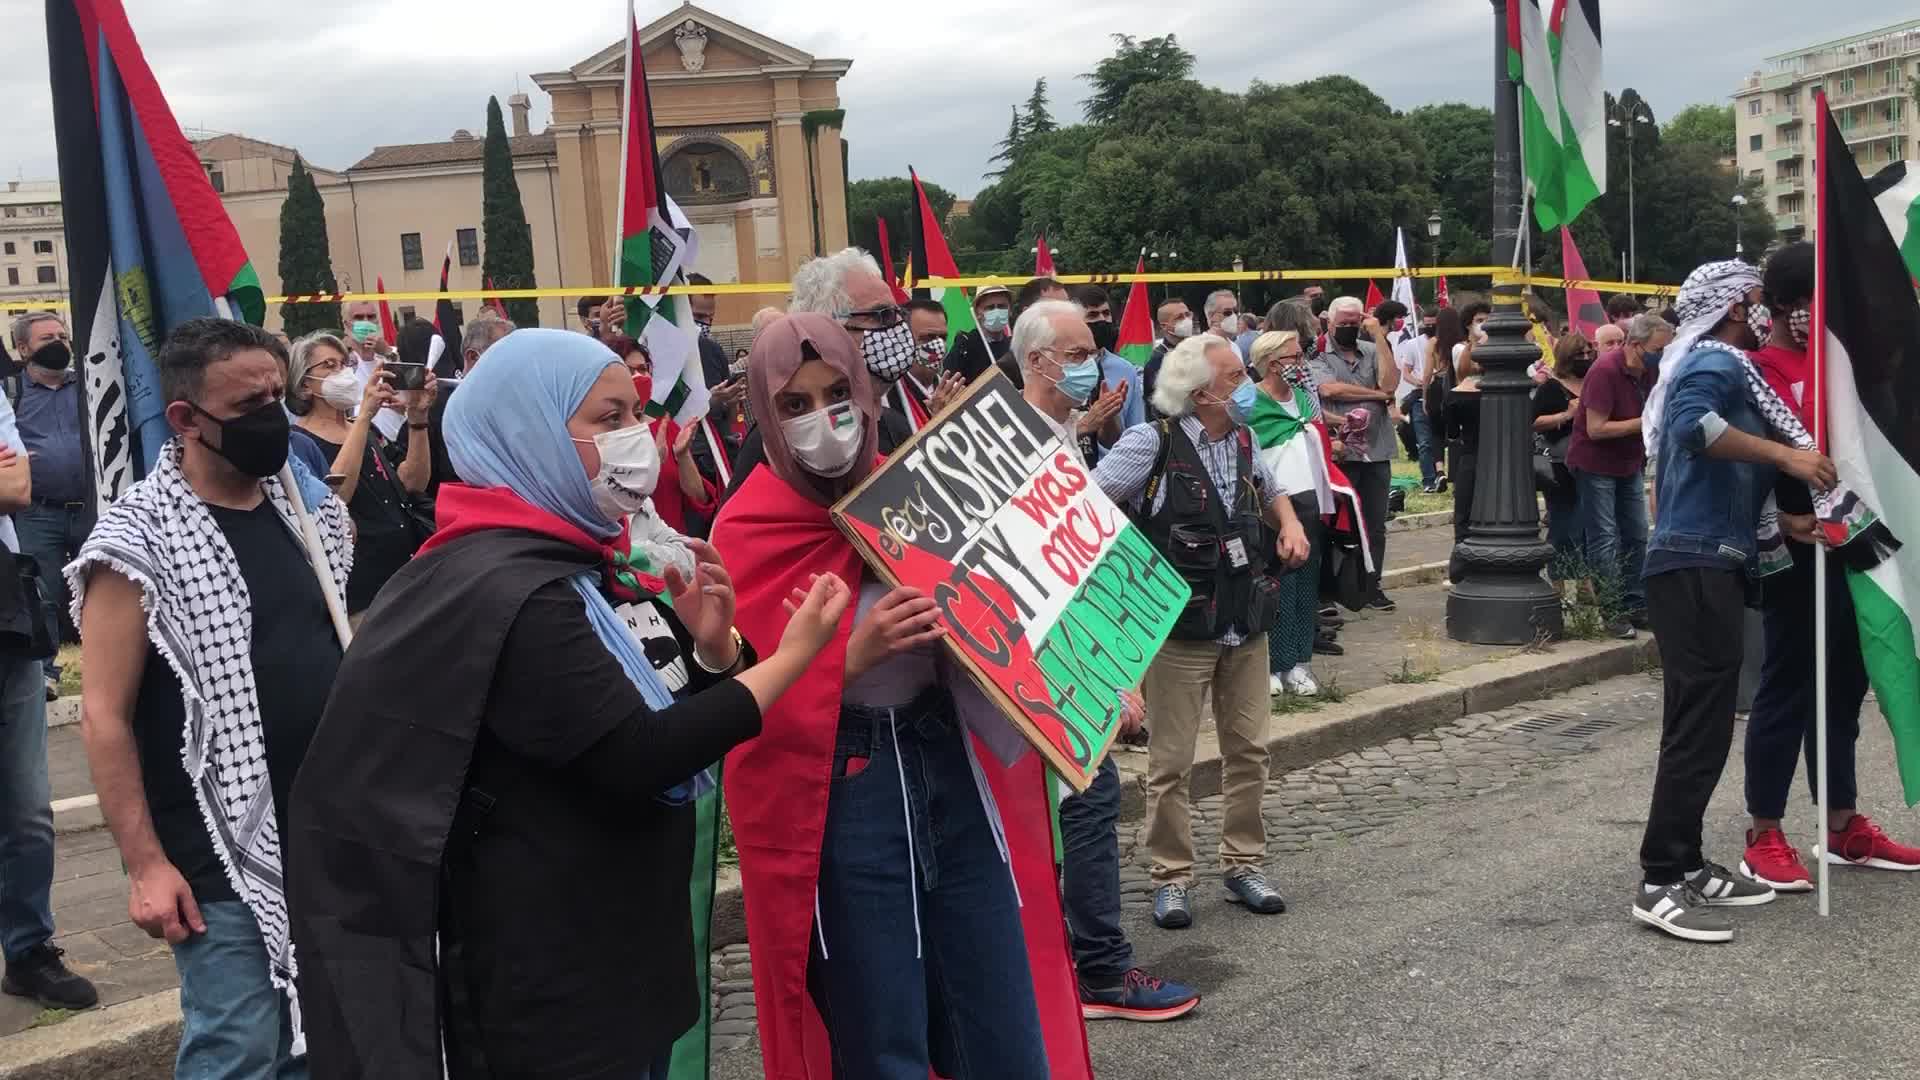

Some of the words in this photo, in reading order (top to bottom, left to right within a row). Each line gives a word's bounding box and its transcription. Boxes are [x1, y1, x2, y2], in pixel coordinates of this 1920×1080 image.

[879, 480, 952, 560] every
[904, 388, 1064, 541] ISRAEL
[934, 523, 1050, 668] CITY
[1010, 452, 1088, 530] was
[1041, 498, 1119, 588] once
